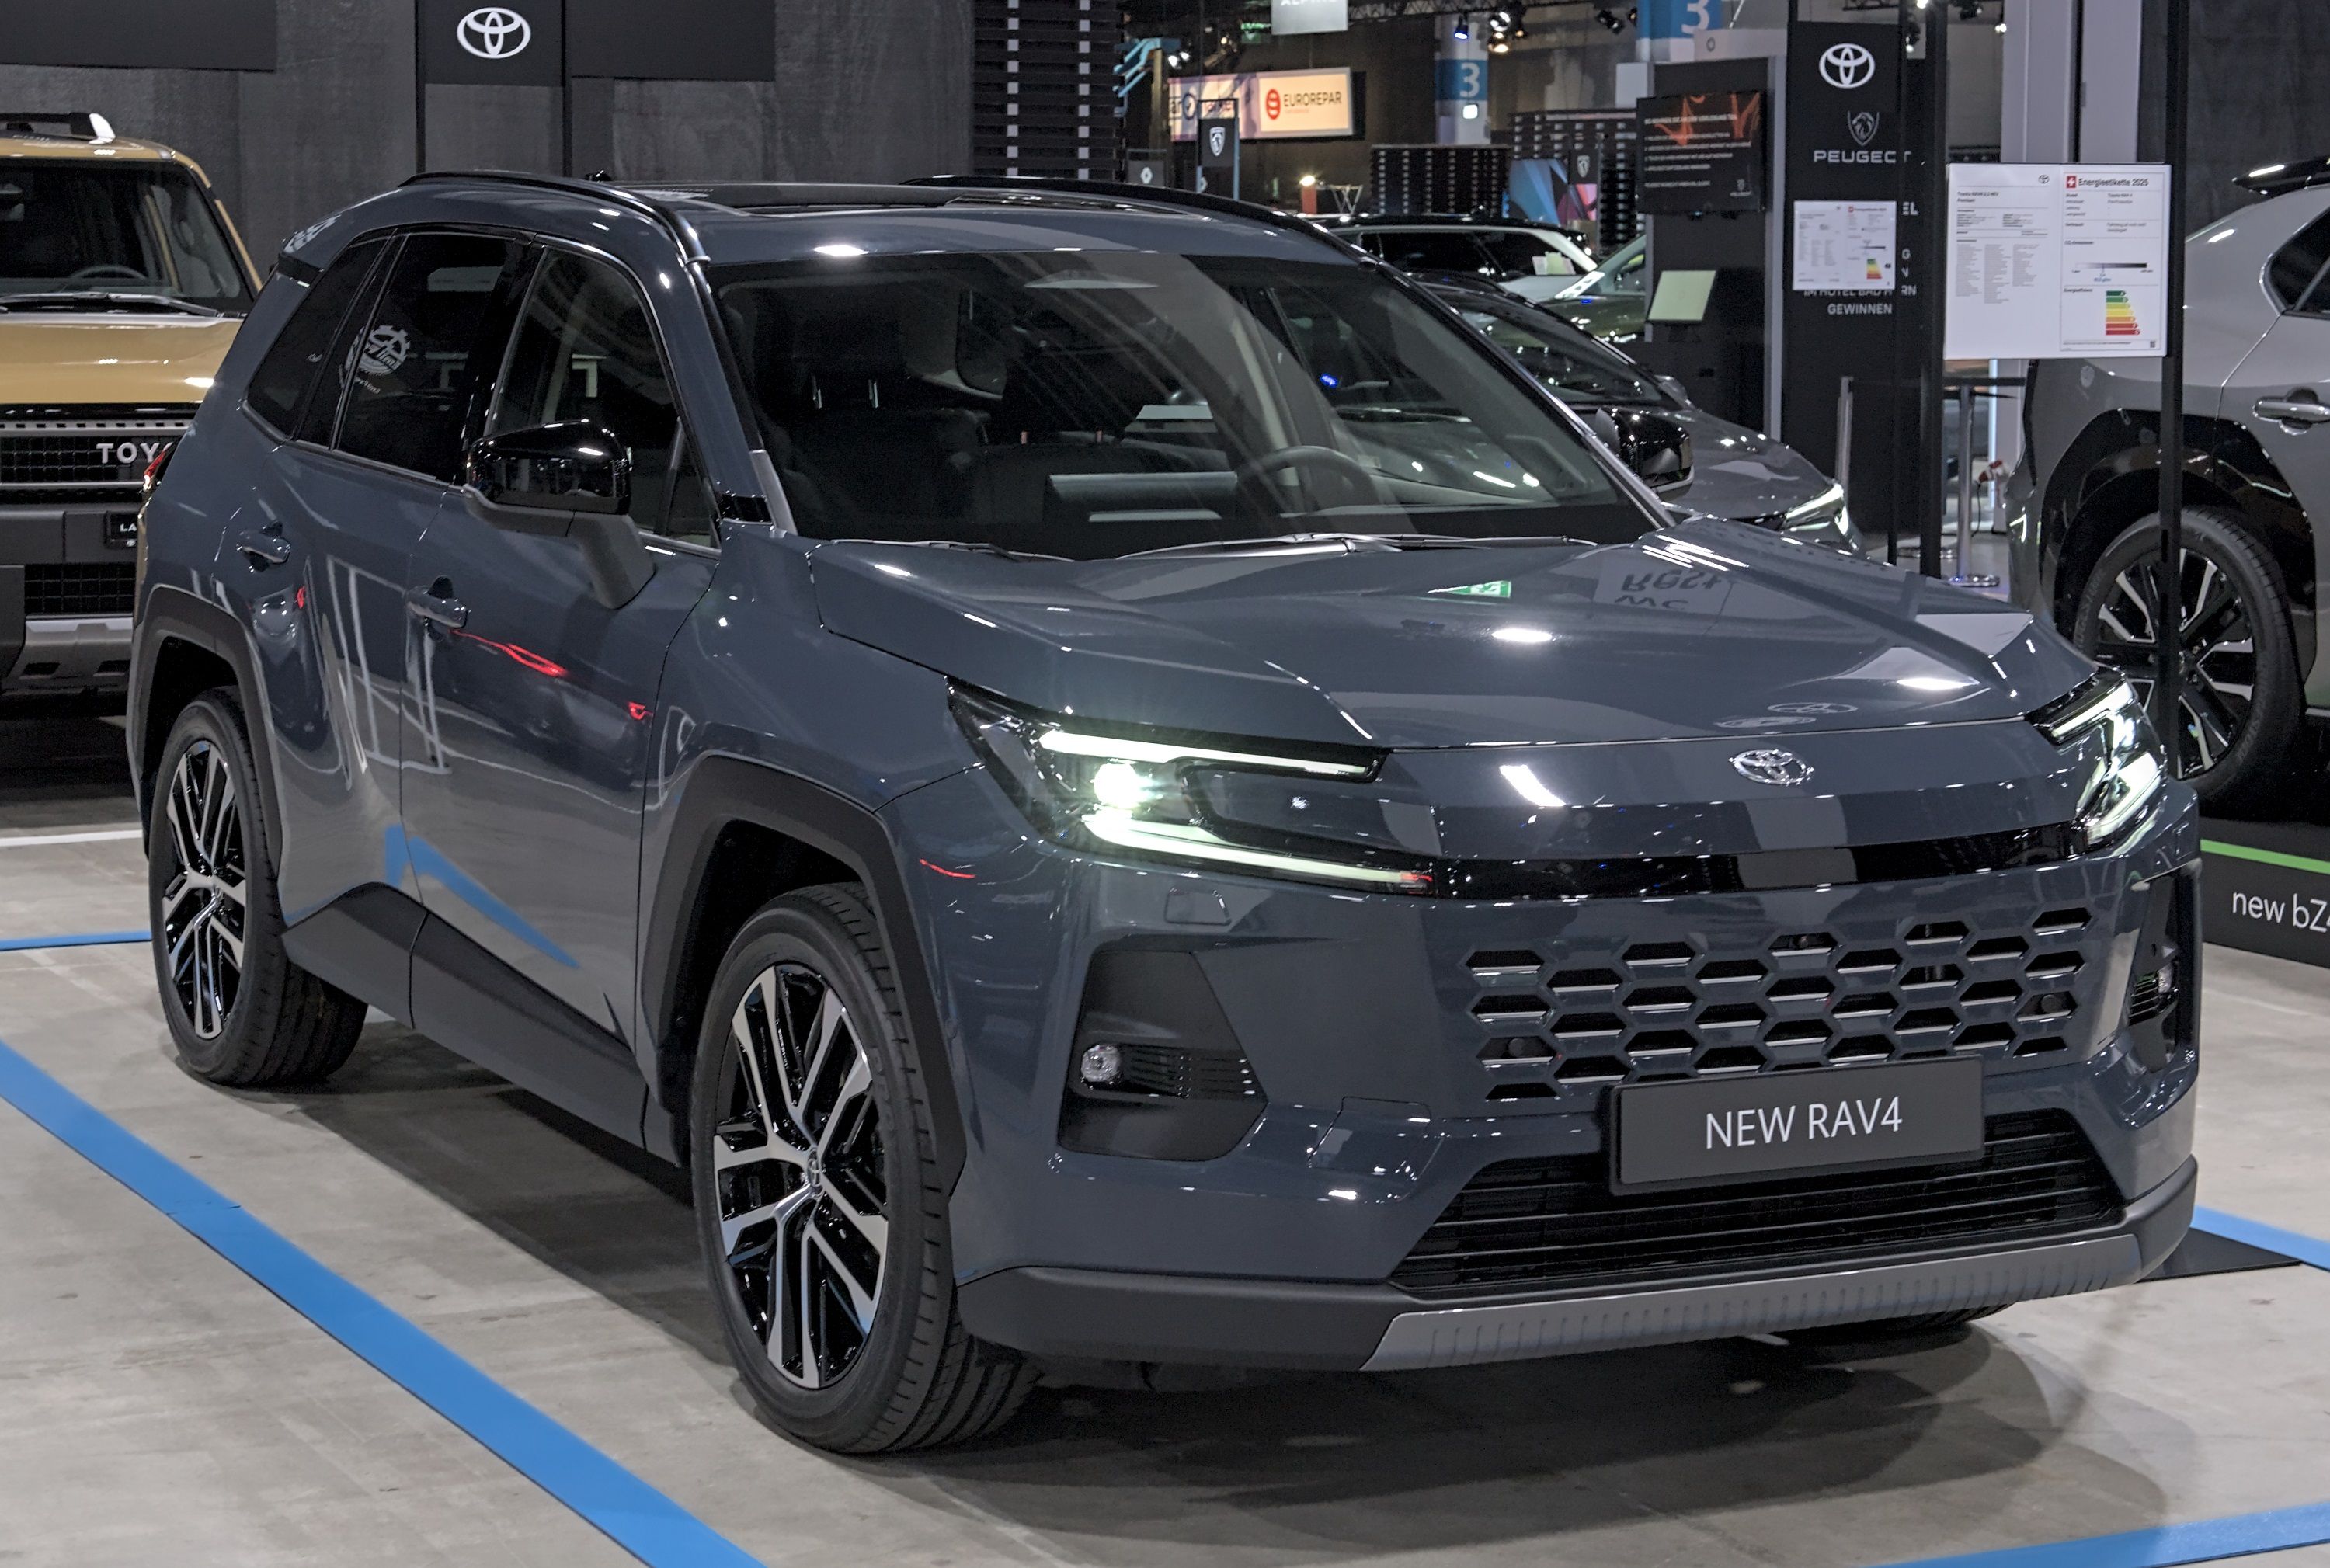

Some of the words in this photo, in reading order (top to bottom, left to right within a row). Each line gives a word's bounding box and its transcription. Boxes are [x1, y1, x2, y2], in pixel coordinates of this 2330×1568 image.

[1460, 62, 1480, 98] 3
[1284, 91, 1342, 107] EUROREPAR
[1827, 304, 1893, 315] GEWINNEN
[96, 442, 173, 464] TOY
[120, 523, 137, 532] LA
[2232, 892, 2286, 923] new
[2292, 893, 2330, 933] bZ
[1706, 1105, 1796, 1149] NEW
[1808, 1096, 1903, 1140] RAV4
